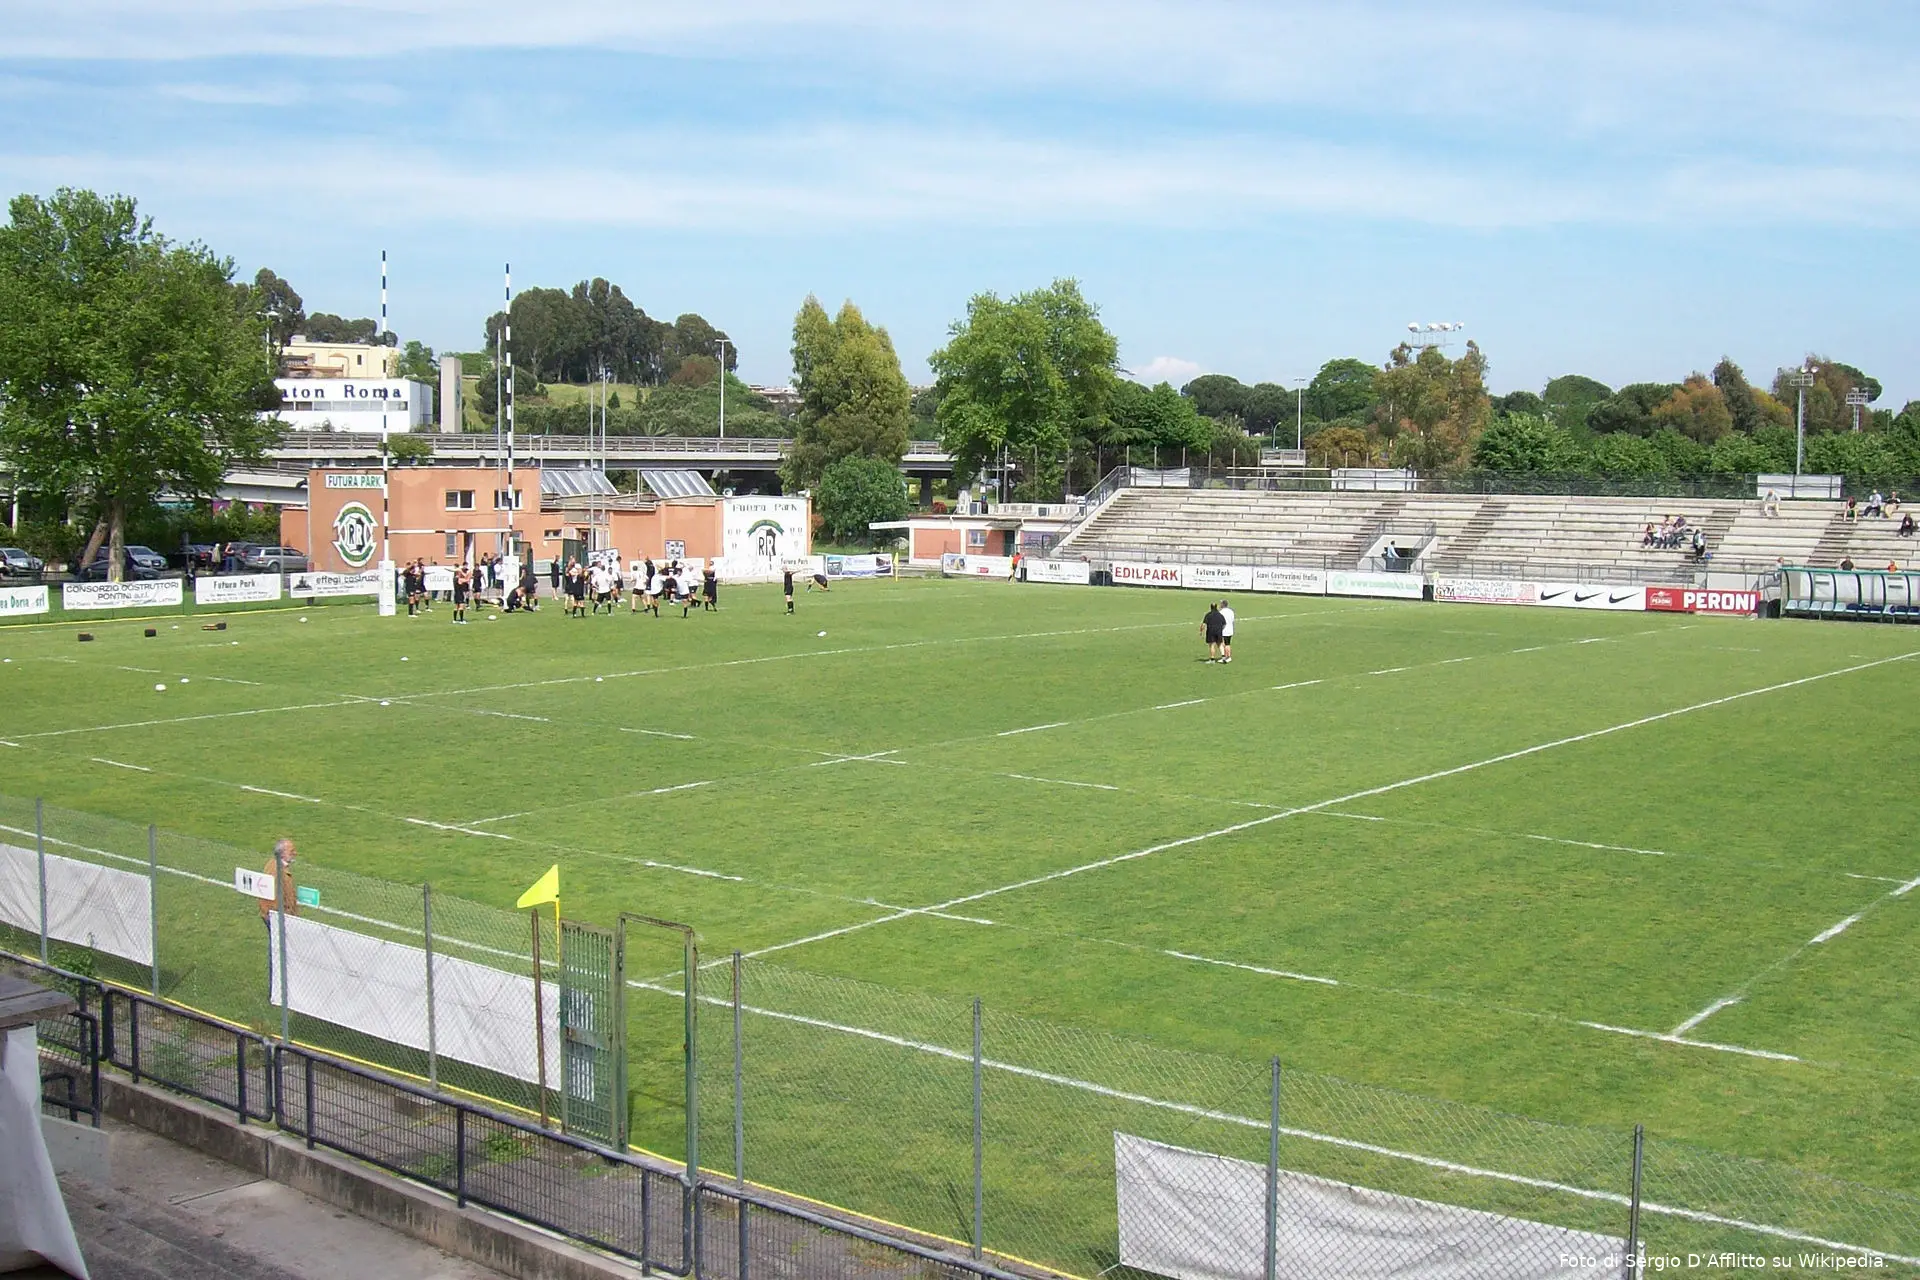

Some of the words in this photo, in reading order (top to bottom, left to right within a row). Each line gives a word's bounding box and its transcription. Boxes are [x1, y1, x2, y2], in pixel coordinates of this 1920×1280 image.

[344, 384, 402, 398] Roma
[328, 475, 358, 487] FUTURA
[360, 475, 381, 487] PARK
[1115, 566, 1178, 581] EDILPARK
[1196, 567, 1215, 576] Futura
[1217, 568, 1230, 577] Park
[66, 584, 120, 593] CONSORZIO
[121, 582, 179, 592] COSTRUTTORI
[213, 580, 237, 590] Futura
[239, 579, 256, 588] Park
[97, 592, 132, 600] PONTINI
[1683, 591, 1756, 611] PERONI
